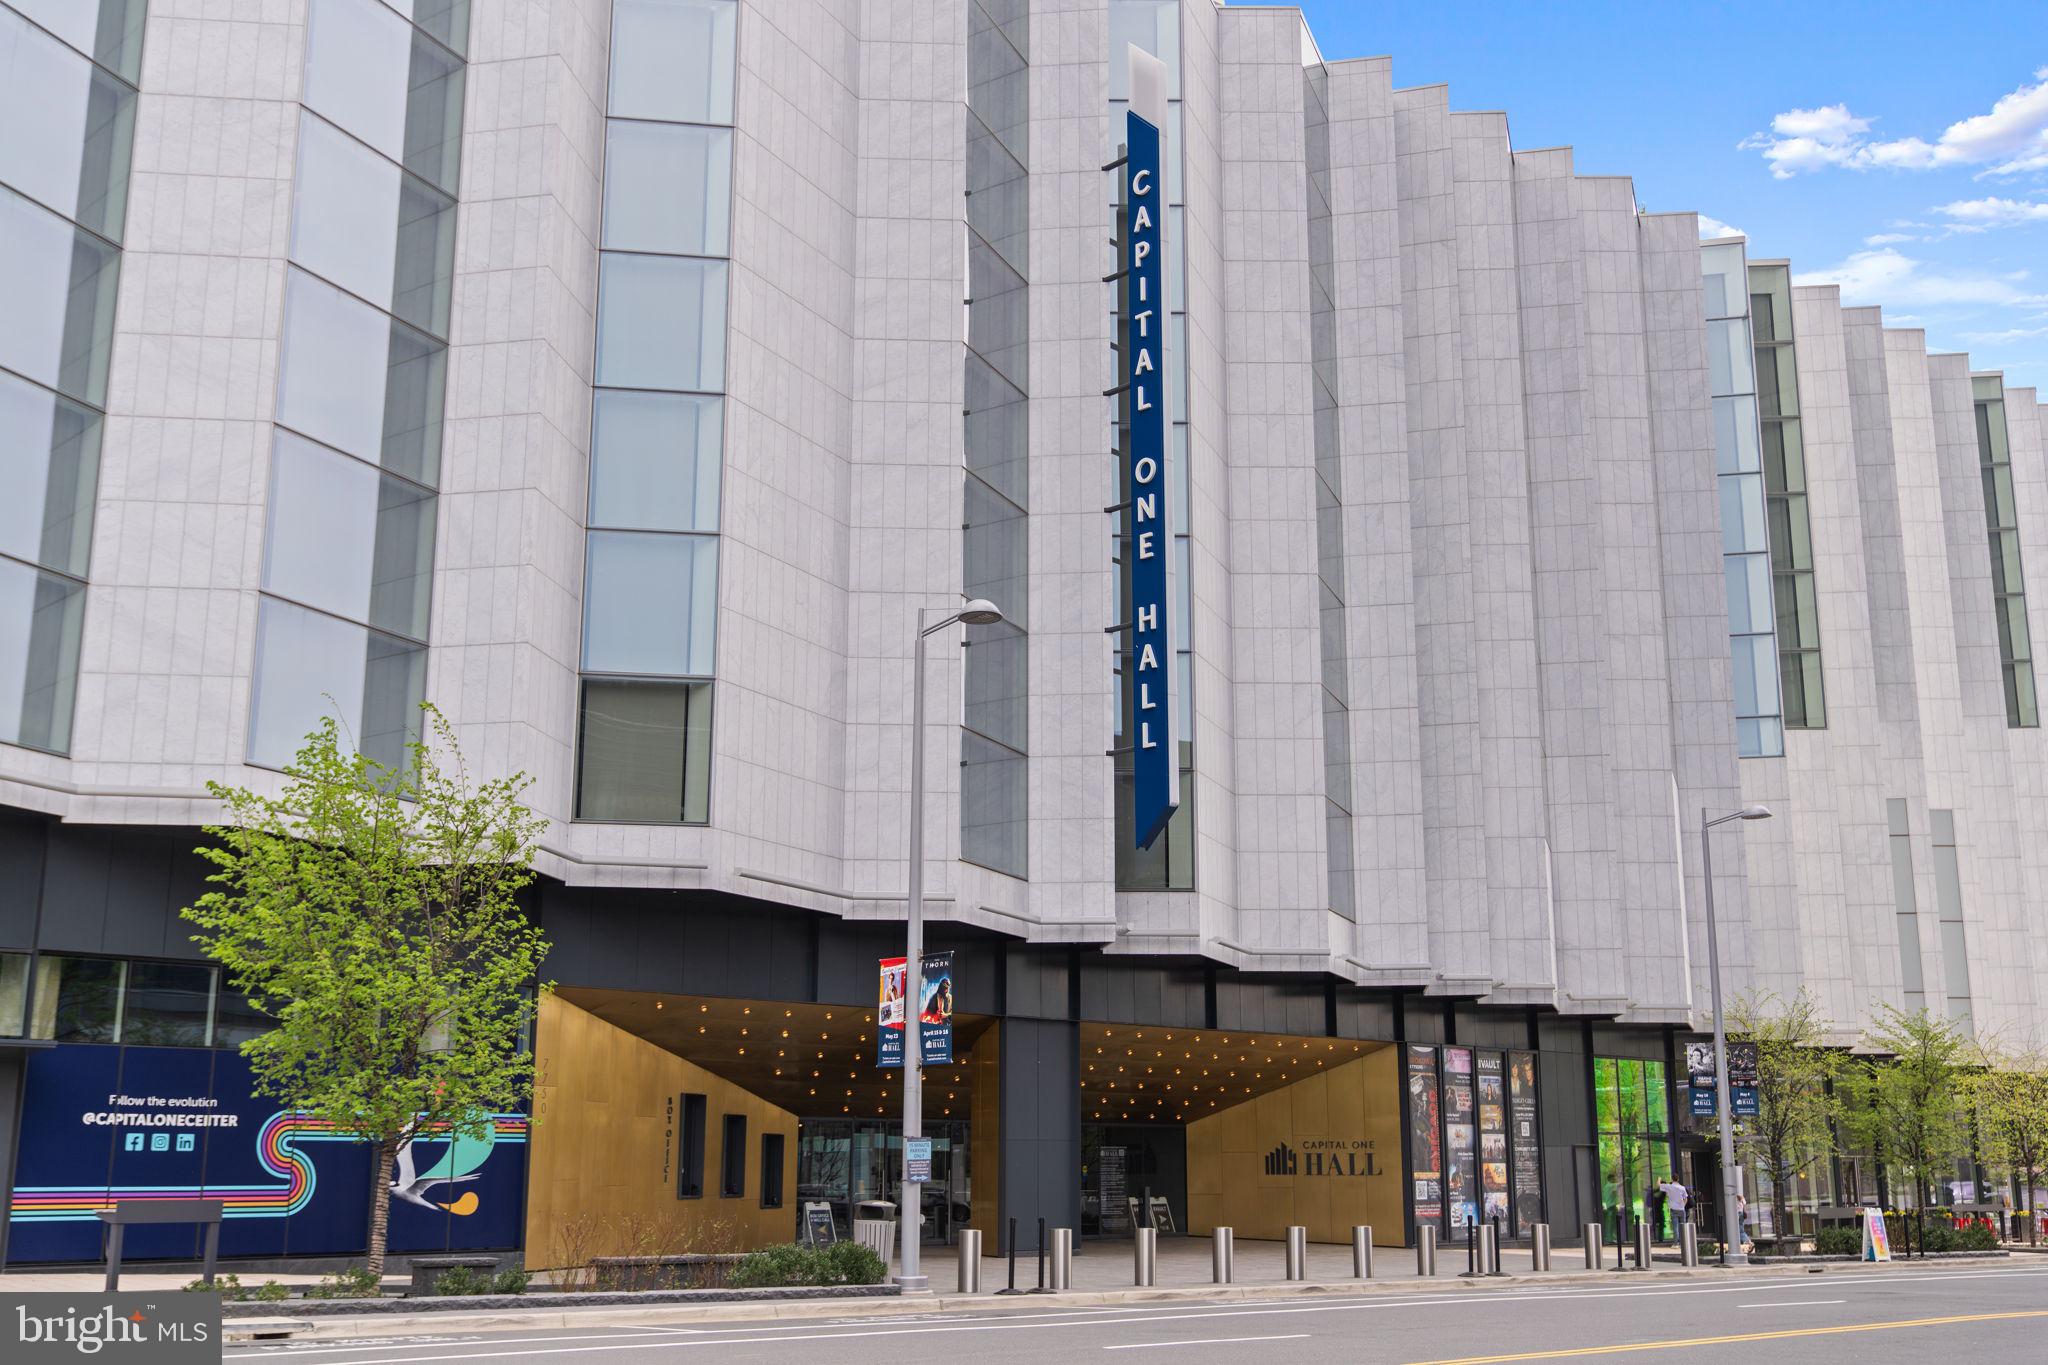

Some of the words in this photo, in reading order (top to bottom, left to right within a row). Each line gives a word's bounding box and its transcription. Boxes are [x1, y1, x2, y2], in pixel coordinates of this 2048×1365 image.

[1132, 169, 1154, 411] CAPITAL
[1135, 457, 1157, 560] ONE
[1138, 604, 1158, 749] HALL
[147, 1096, 167, 1107] the
[541, 1058, 550, 1114] 7750
[1302, 1141, 1348, 1149] CAPITAL
[1351, 1141, 1375, 1149] ONE
[1304, 1152, 1383, 1176] HALL
